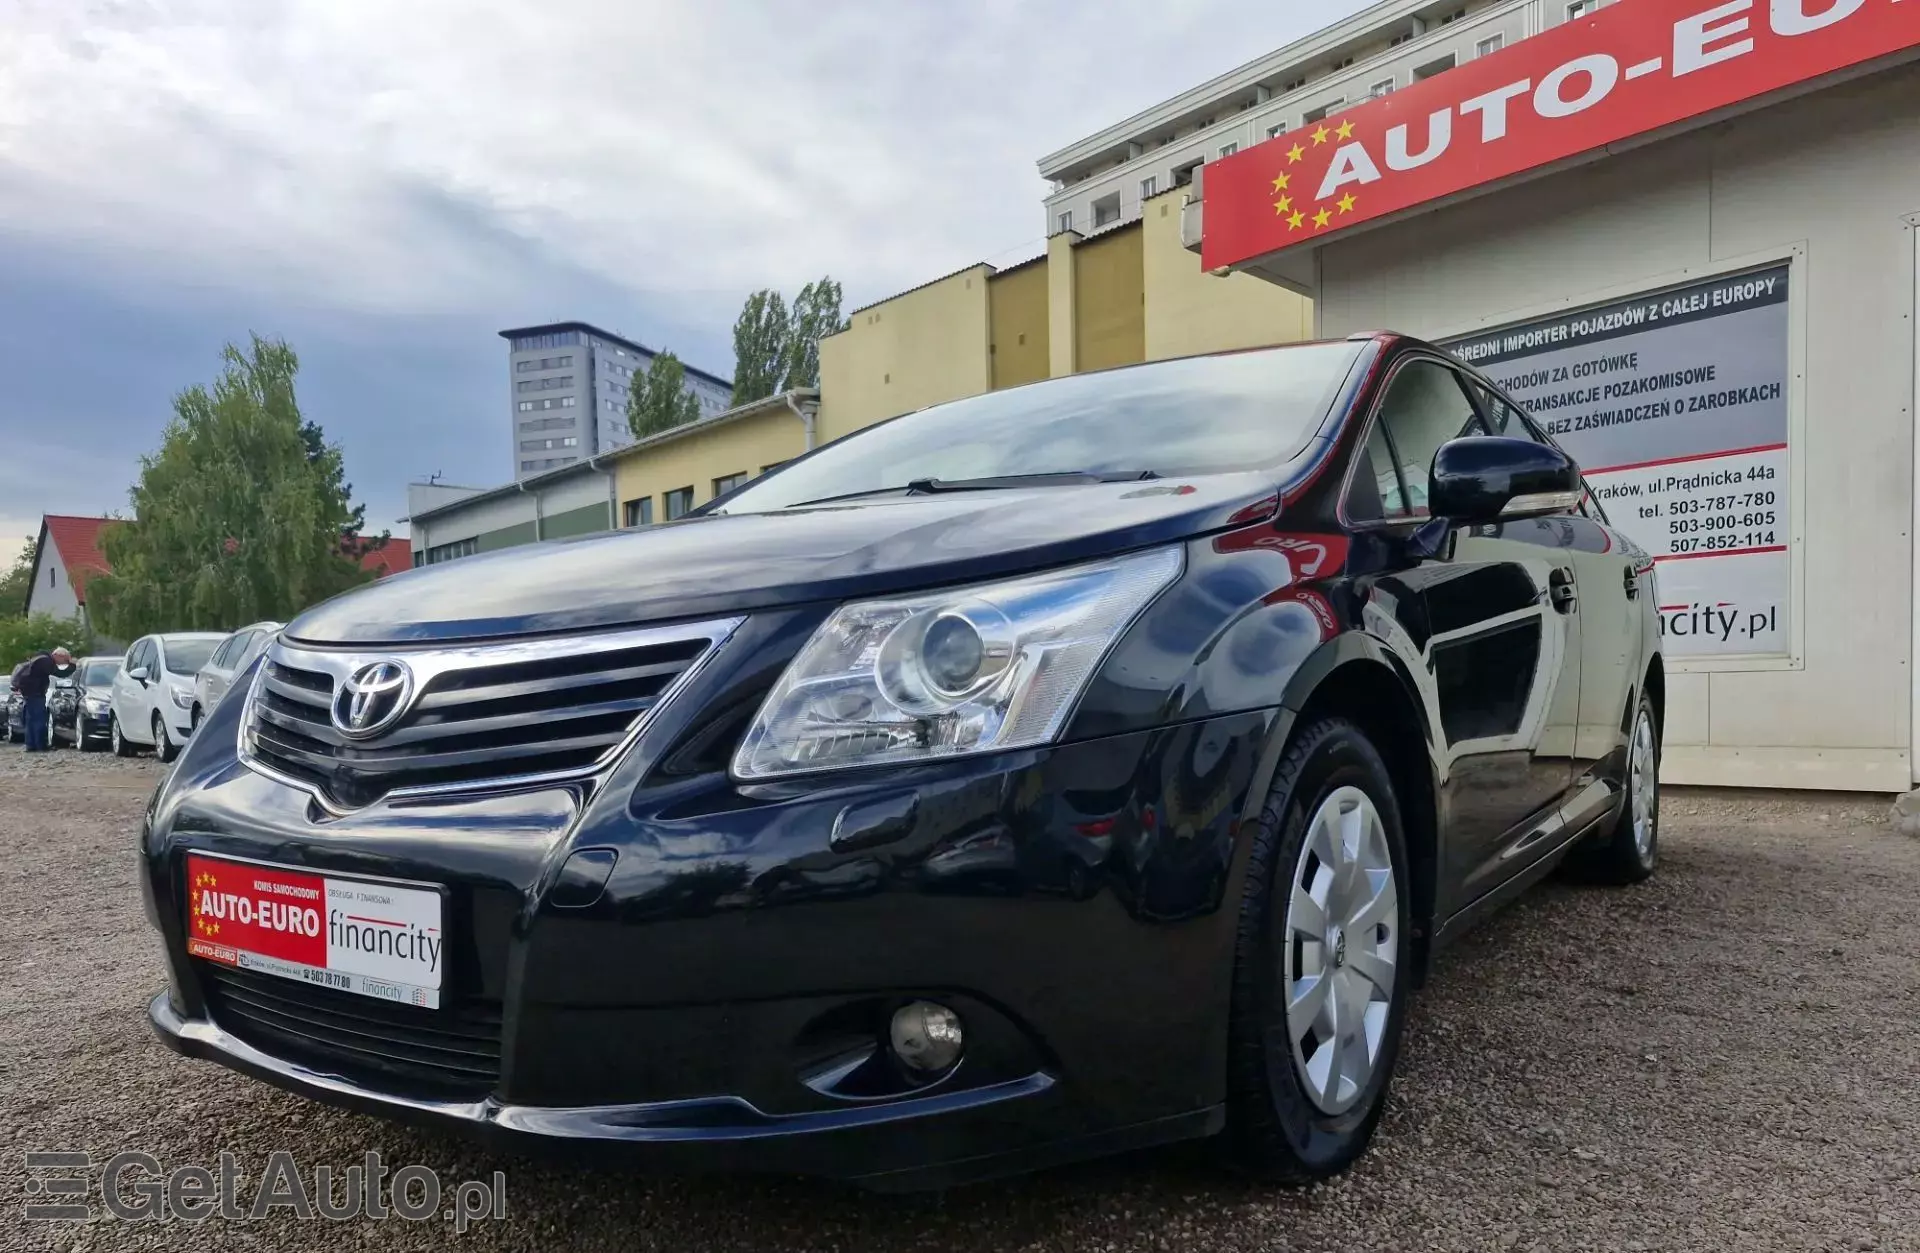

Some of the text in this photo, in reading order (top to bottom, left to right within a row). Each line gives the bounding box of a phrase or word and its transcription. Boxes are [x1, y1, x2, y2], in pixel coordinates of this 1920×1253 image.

[1504, 324, 1568, 352] IMPORTER
[1571, 306, 1646, 338] POJAZDÓW
[1649, 304, 1659, 321] Z
[1662, 293, 1708, 318] CAŁEJ
[1712, 277, 1776, 306] EUROPY
[1552, 366, 1569, 382] ZA
[1572, 352, 1638, 377] GOTÓWKĘ
[1604, 365, 1716, 400] POZAKOMISOWE
[1547, 382, 1781, 436] BEZ ZAŚWIADCZEŃ O ZAROBKACH
[1648, 470, 1742, 494] ul.Prądnicka
[1746, 465, 1775, 482] 44a
[1639, 491, 1775, 519] tel. 503-787-780
[1669, 511, 1775, 535] 503-900-605
[1670, 531, 1775, 553] 507-852-114
[254, 879, 320, 900] KOMIS SAMOCHODOWY
[200, 889, 320, 938] AUTO-EURO
[193, 944, 236, 962] AUTO-EURO
[329, 909, 442, 973] financity
[311, 970, 351, 989] 503 78 77 80
[362, 977, 403, 1000] financity
